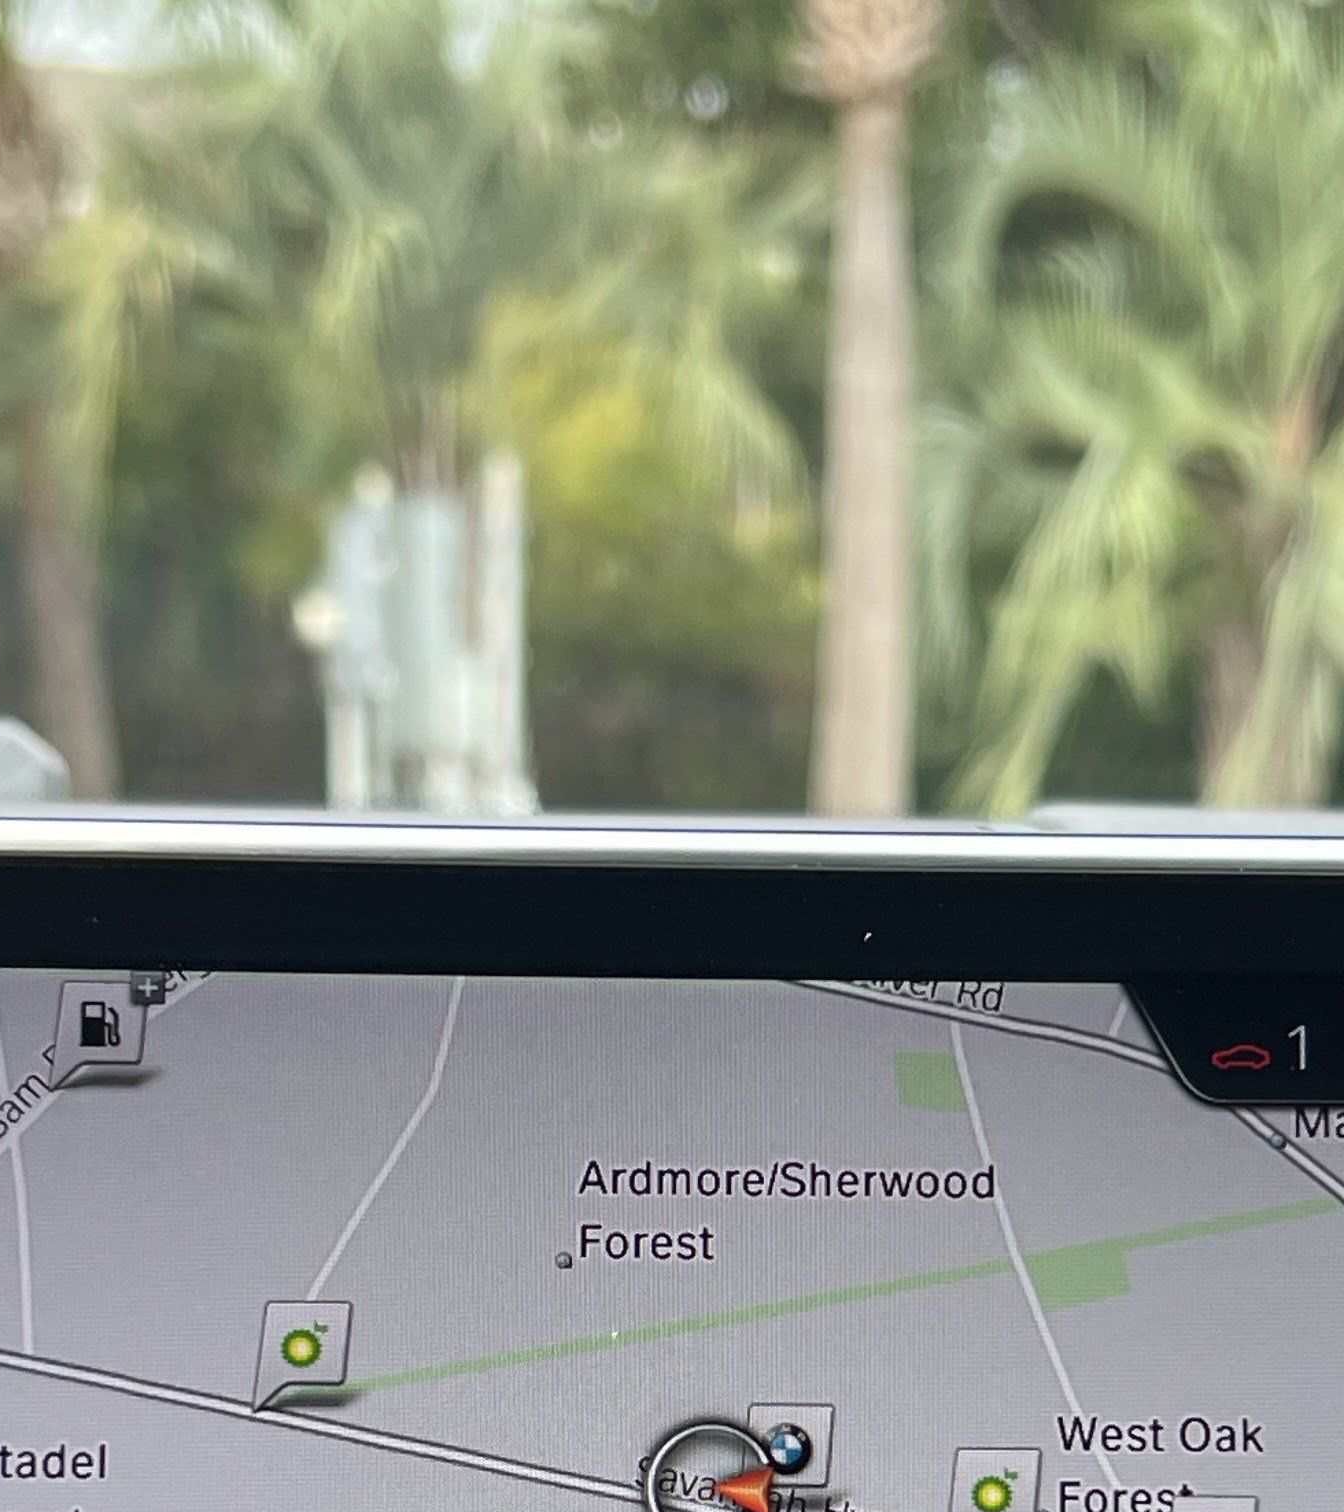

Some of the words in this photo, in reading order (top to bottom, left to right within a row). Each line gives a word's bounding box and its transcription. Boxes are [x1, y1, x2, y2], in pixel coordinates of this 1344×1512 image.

[957, 981, 1005, 1012] Rd
[1287, 1023, 1307, 1072] 1
[577, 1159, 996, 1199] Ardmore/Sherwood
[578, 1223, 715, 1261] Forest
[1056, 1415, 1165, 1452] West
[1179, 1416, 1264, 1453] Oak
